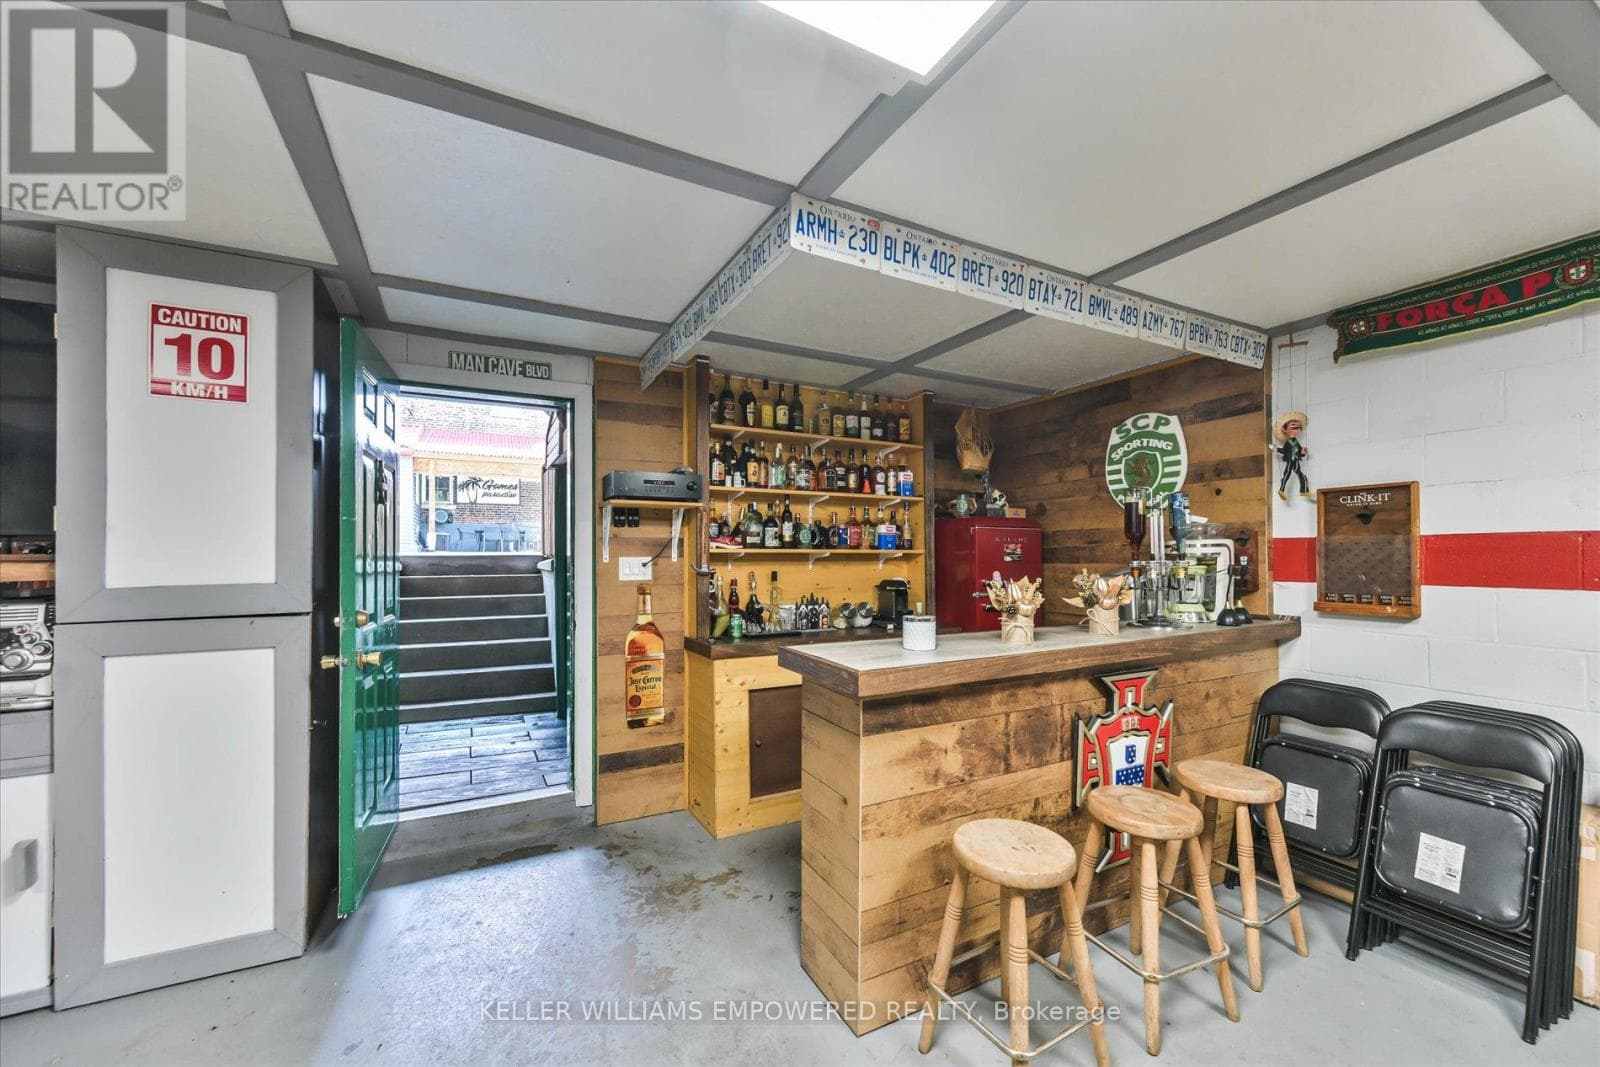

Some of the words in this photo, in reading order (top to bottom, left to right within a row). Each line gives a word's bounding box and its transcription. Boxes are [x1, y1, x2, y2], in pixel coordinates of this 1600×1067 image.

[796, 208, 838, 246] ARMH
[848, 225, 878, 256] 230
[752, 233, 772, 273] BRET
[884, 235, 920, 269] BLPK
[930, 249, 956, 278] 402
[738, 257, 751, 287] 303
[962, 258, 994, 288] BRET
[1000, 270, 1024, 297] 920
[1028, 278, 1057, 305] BTAY
[1064, 288, 1083, 312] 721
[1375, 286, 1510, 332] FORÇA
[157, 308, 242, 333] CAUTION
[1088, 295, 1113, 321] BMVL
[1119, 303, 1139, 327] 489
[1142, 311, 1165, 332] AZMY
[1169, 317, 1185, 339] 767
[1214, 329, 1229, 349] 763
[1230, 334, 1249, 355] CBTX
[164, 333, 235, 381] 10
[451, 352, 484, 373] MAN
[489, 357, 524, 377] CAVE
[526, 364, 549, 379] BLVD
[171, 381, 228, 399] KM/H
[1115, 414, 1171, 440] SCP
[1111, 438, 1174, 461] SPORTING
[1340, 493, 1391, 504] CLINK-IT
